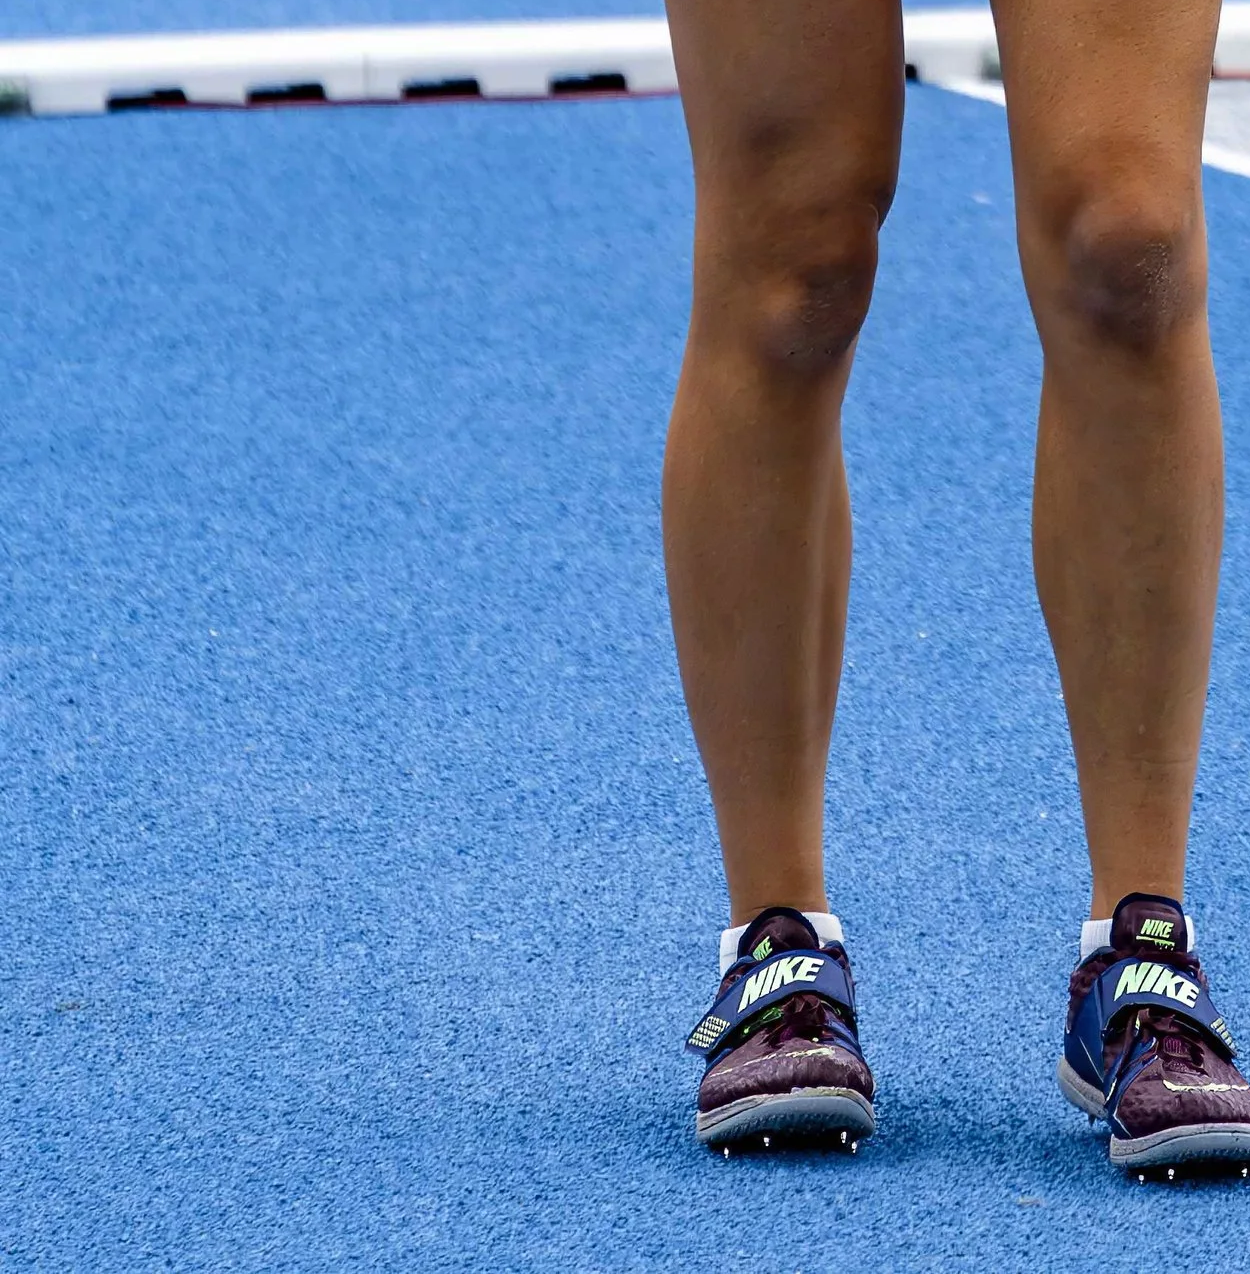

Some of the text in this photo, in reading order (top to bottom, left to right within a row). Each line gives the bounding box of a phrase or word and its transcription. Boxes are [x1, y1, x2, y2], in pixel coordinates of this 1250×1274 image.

[1140, 918, 1174, 939] NIKE
[738, 956, 824, 1013] NIKE
[1113, 961, 1200, 1009] NIKE
